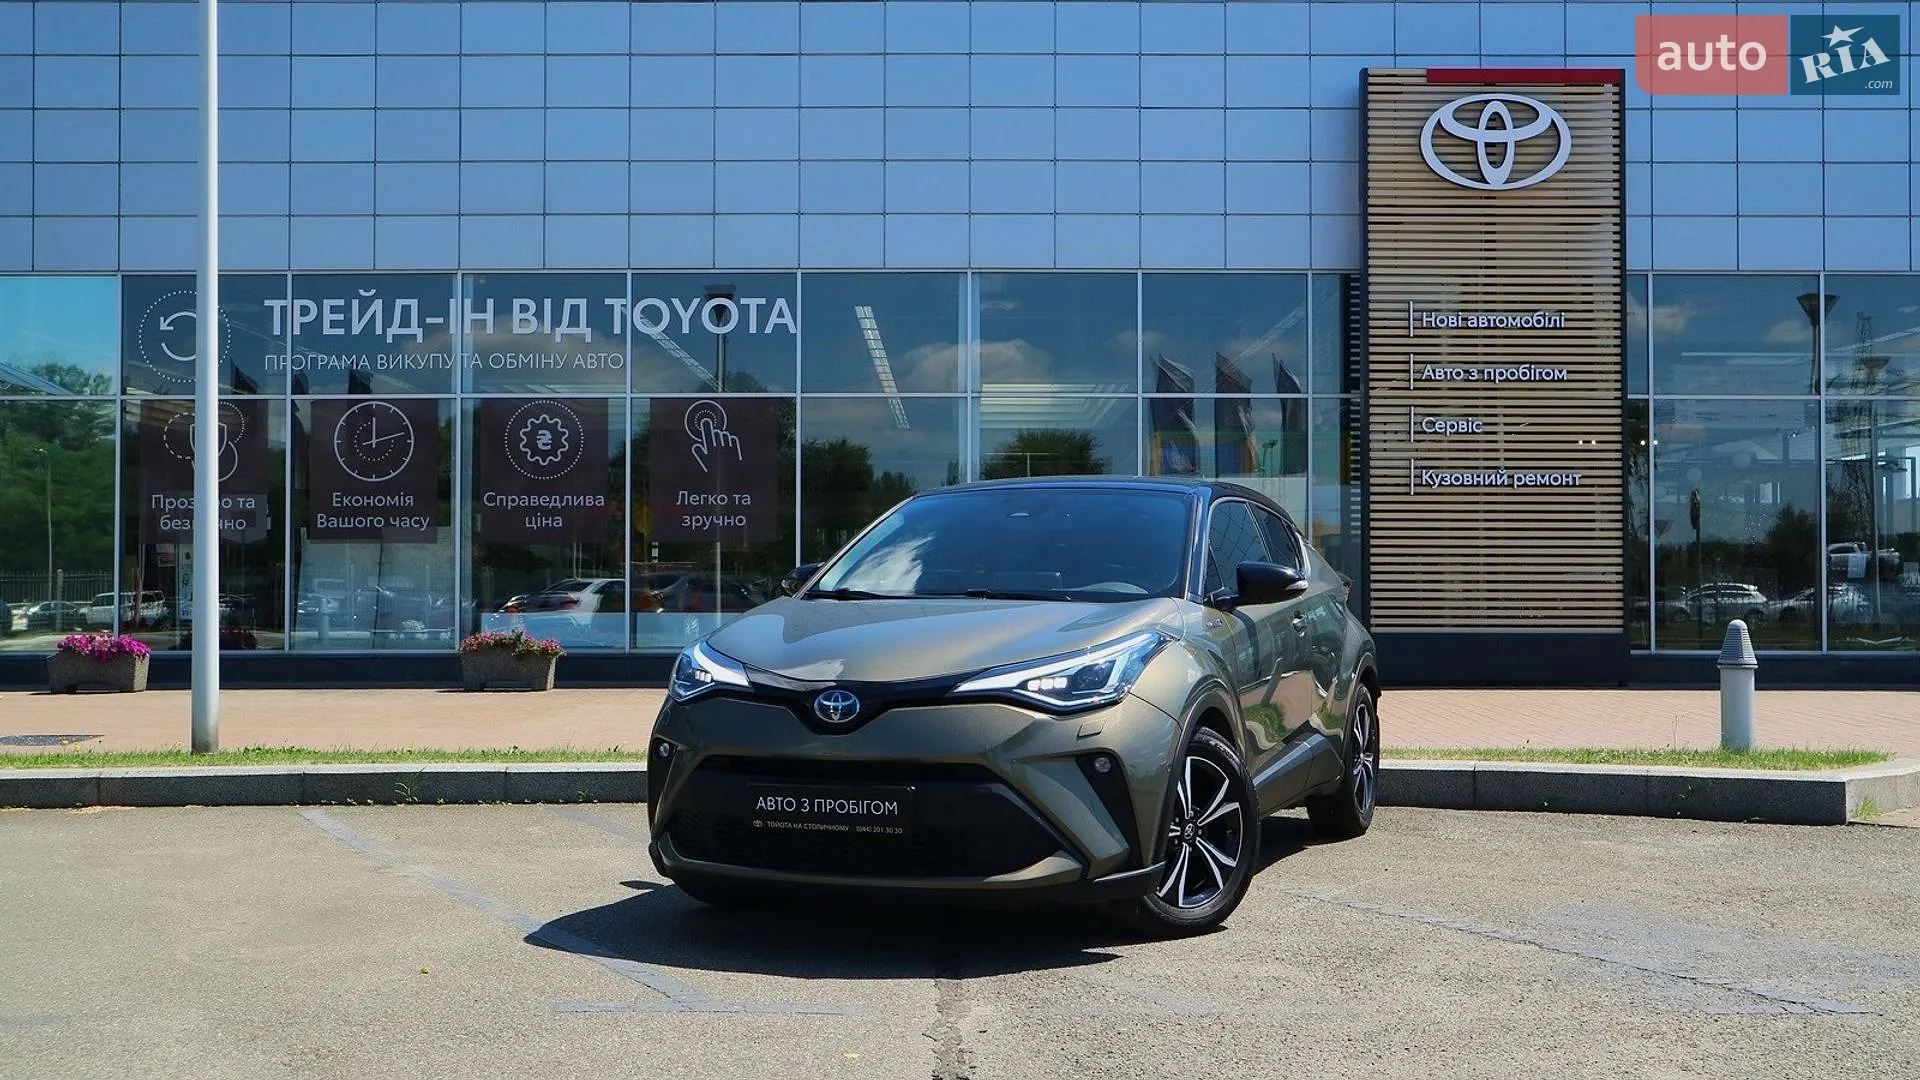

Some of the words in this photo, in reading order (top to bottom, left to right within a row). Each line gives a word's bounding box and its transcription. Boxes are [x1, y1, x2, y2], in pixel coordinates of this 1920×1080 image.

[264, 289, 494, 344] ТРЕЙД-ІН
[512, 298, 592, 343] ВІД
[1422, 312, 1462, 328] Нові
[1467, 312, 1565, 328] автомобілі
[265, 354, 371, 370] ПРОГРАМА
[377, 353, 456, 370] ВИКУПУ
[461, 352, 482, 369] ТА
[489, 352, 567, 369] ОБМІНУ
[573, 352, 624, 369] АВТО
[1422, 365, 1464, 380] Авто
[1469, 369, 1478, 380] з
[1484, 365, 1568, 383] пробігом
[1422, 418, 1482, 436] Сервіс
[1421, 470, 1508, 489] Кузовний
[1514, 474, 1582, 488] ремонт
[152, 494, 232, 512] Прозо
[237, 498, 255, 508] та
[332, 492, 414, 507] Економія
[483, 492, 605, 509] Справедлива
[676, 491, 728, 505] Легко
[733, 495, 751, 505] та
[317, 514, 384, 528] Вашого
[390, 515, 430, 531] часу
[525, 515, 563, 529] ціна
[682, 515, 746, 531] зручно
[756, 797, 796, 812] АВТО
[814, 799, 899, 816] ПРОБІГОМ
